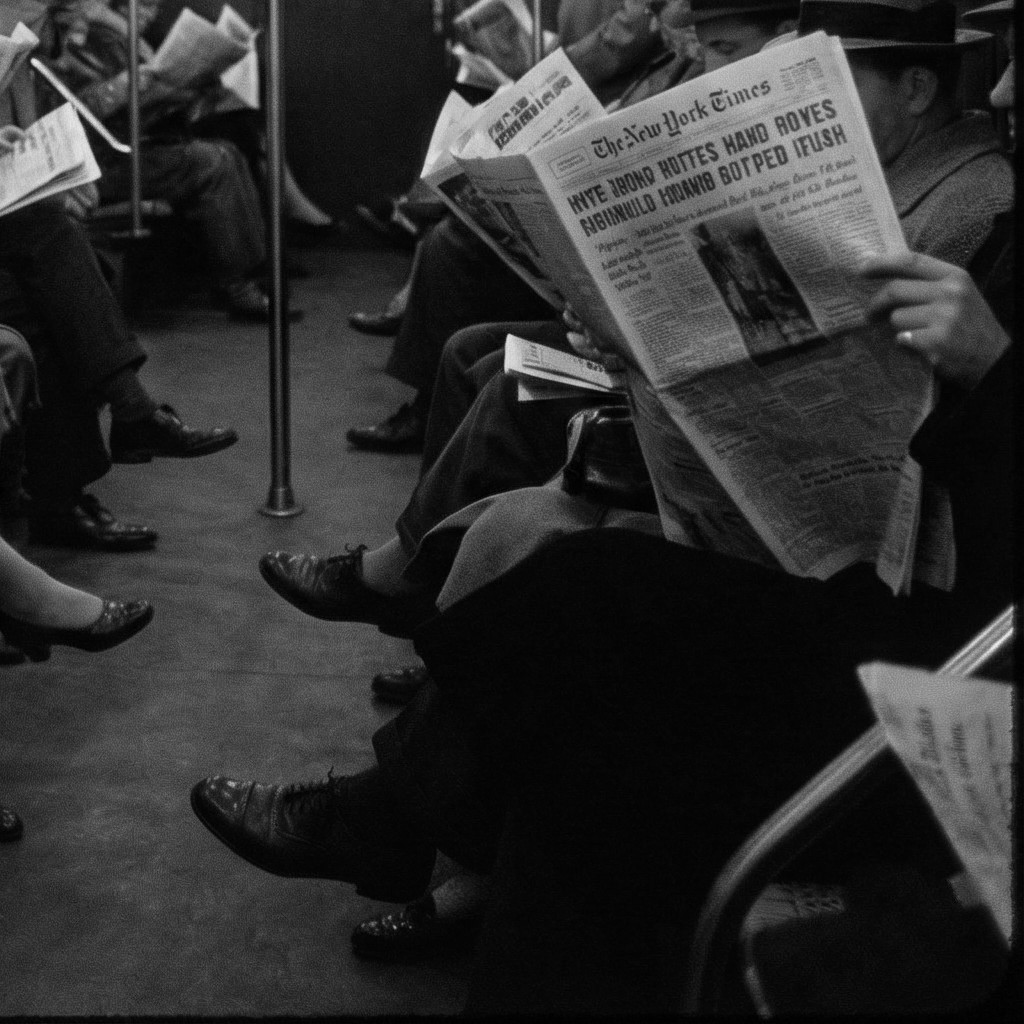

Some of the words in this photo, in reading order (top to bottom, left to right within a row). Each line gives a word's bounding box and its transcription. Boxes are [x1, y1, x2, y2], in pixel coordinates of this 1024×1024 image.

[591, 135, 624, 159] The
[623, 123, 662, 149] New
[662, 99, 709, 137] York
[709, 79, 772, 112] Times
